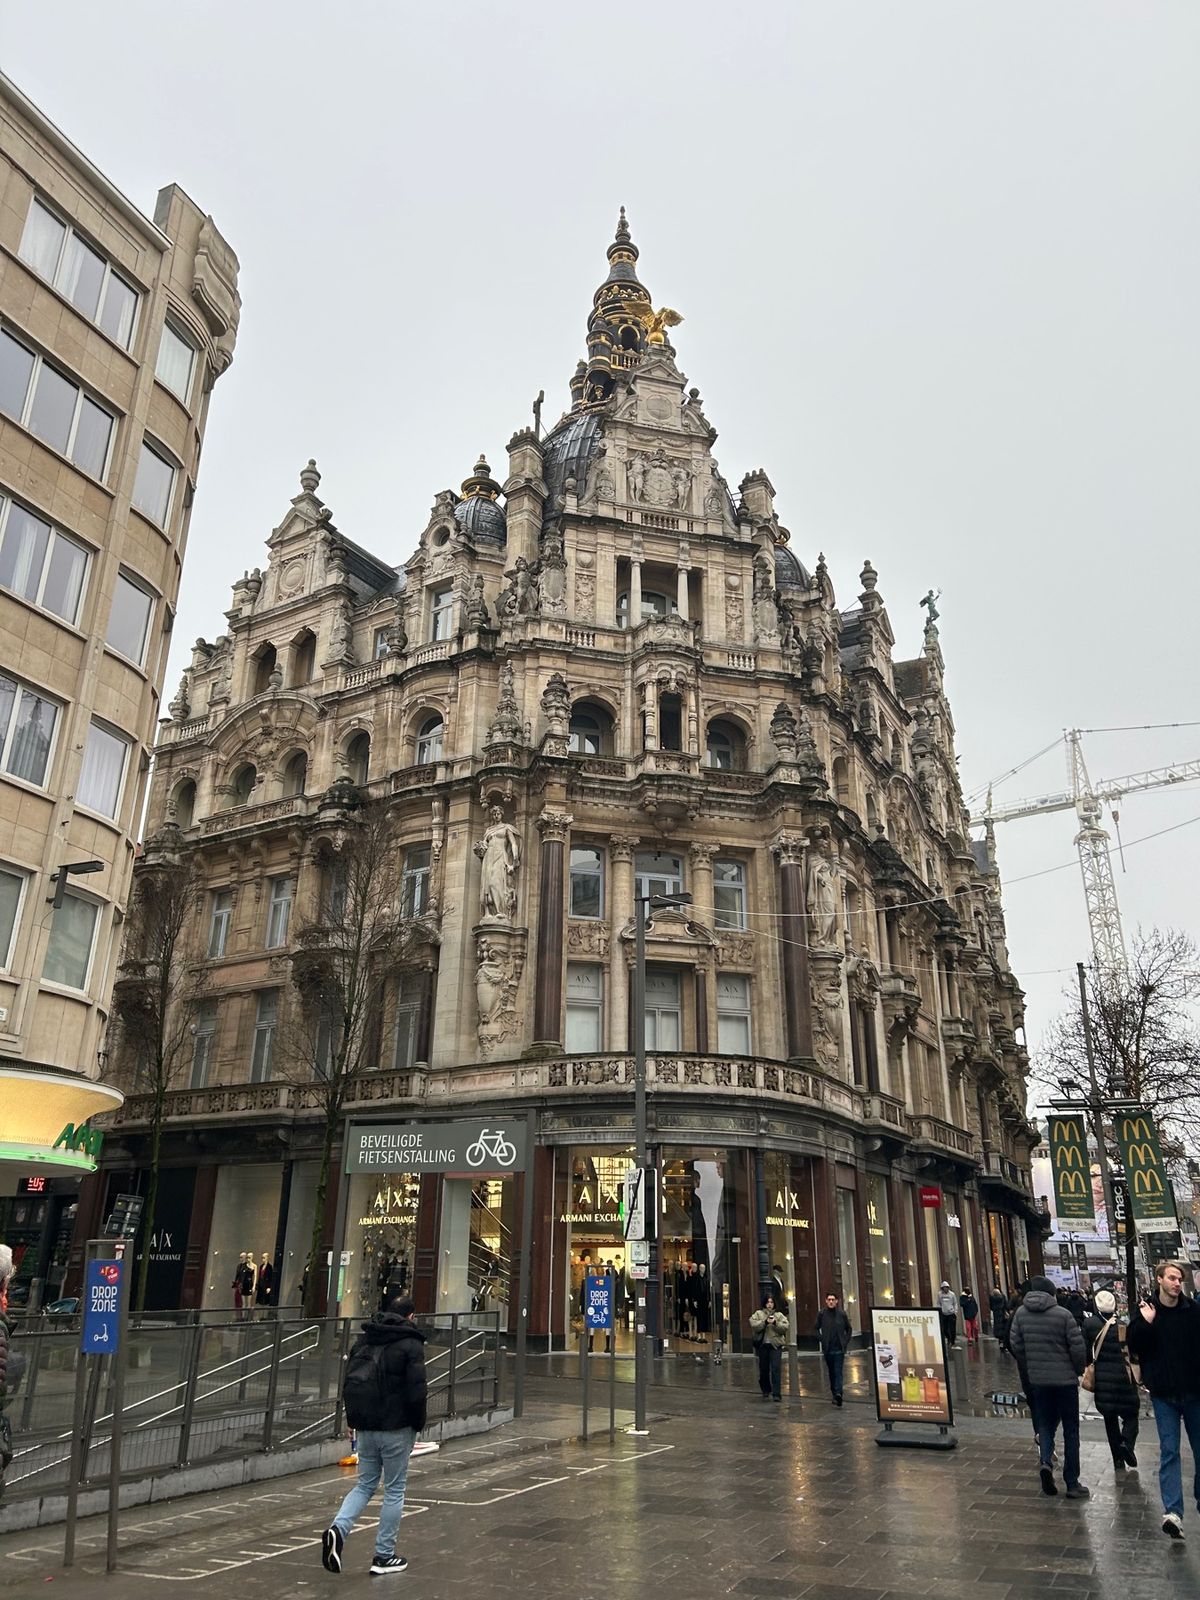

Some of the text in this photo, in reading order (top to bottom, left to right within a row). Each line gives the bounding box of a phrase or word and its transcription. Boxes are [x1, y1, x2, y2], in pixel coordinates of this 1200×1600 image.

[360, 1134, 423, 1148] BEVEILIGDE
[358, 1150, 456, 1164] FIETSENSTALLING
[1114, 1185, 1126, 1220] fnac
[358, 1215, 417, 1225] ARMANI EXCHANGE
[560, 1214, 592, 1222] ARMANI
[784, 1218, 809, 1229] EXCHANGE
[91, 1286, 118, 1299] DROP
[590, 1290, 609, 1298] DROP
[878, 1315, 934, 1324] SCENTIMENT
